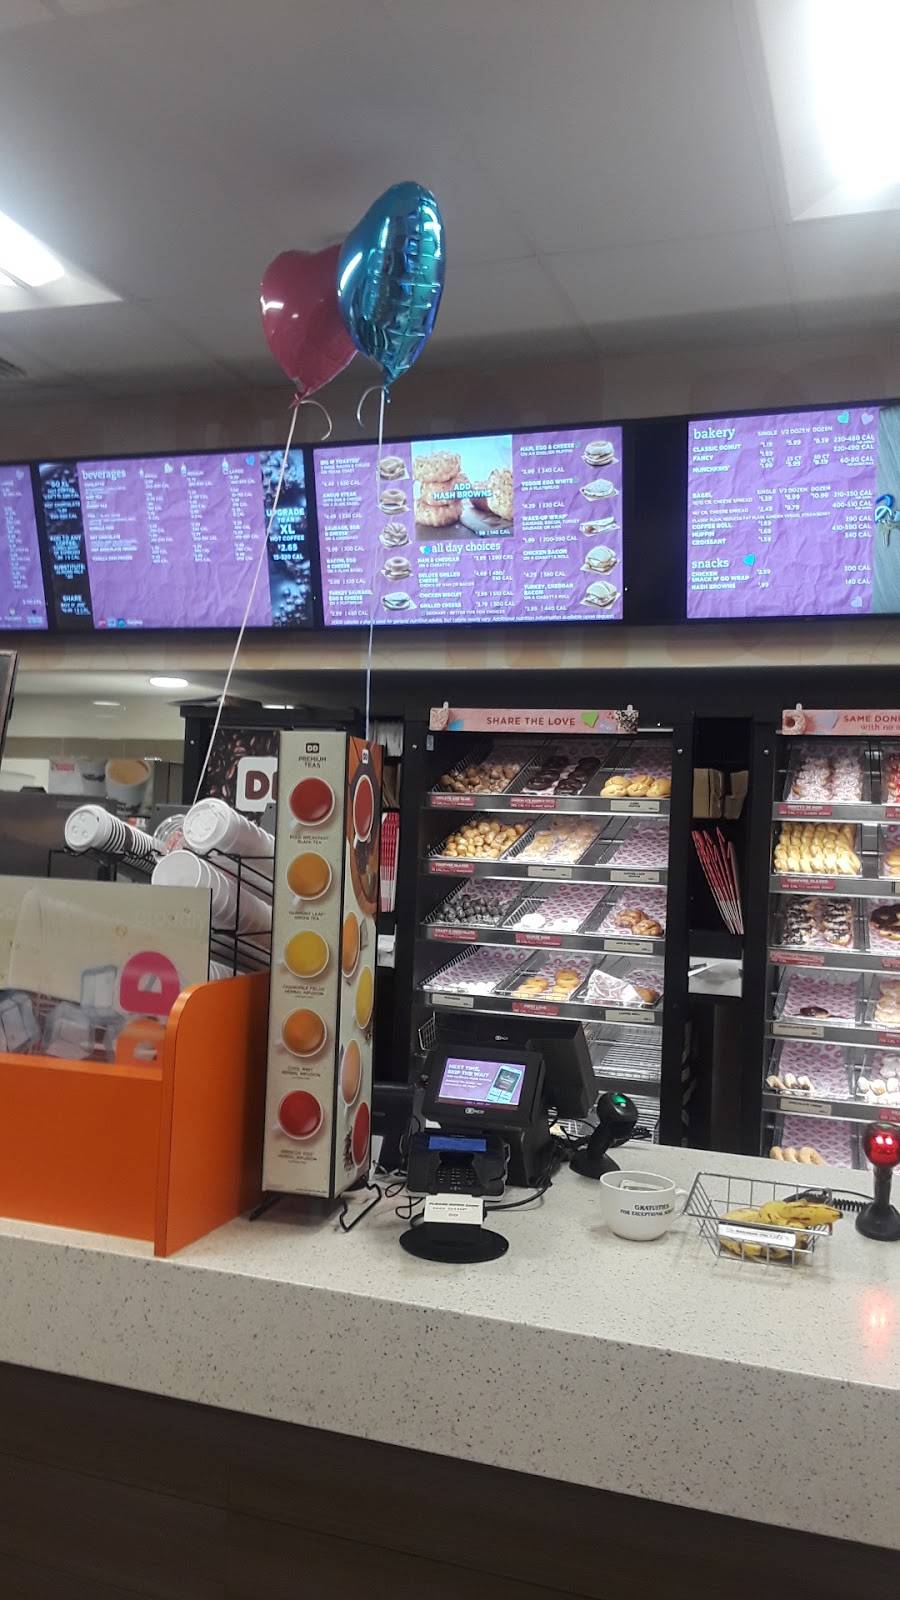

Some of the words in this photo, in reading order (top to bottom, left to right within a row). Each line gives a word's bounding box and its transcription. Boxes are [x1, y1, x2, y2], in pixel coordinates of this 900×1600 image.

[693, 427, 736, 442] bakery
[812, 425, 833, 433] DOZEN
[719, 443, 742, 452] DONUT
[862, 433, 874, 441] CAL
[81, 470, 127, 481] beverages
[454, 483, 471, 491] ADD
[433, 491, 456, 500] HASH
[456, 490, 493, 499] BROWNS
[692, 492, 713, 500] BAGEL
[859, 488, 872, 496] CAL
[858, 500, 872, 508] CAL
[280, 524, 296, 535] XL
[282, 534, 305, 542] COFFEE
[692, 538, 727, 546] CROISSANT
[431, 543, 444, 553] all
[445, 543, 463, 555] day
[465, 542, 501, 552] choices
[691, 557, 730, 570] snacks
[487, 716, 520, 726] SHARE
[524, 717, 545, 726] THE
[548, 717, 576, 727] LOVE
[843, 714, 873, 723] SAME
[620, 1208, 630, 1216] FOR
[634, 1203, 670, 1212] GRATUITIES
